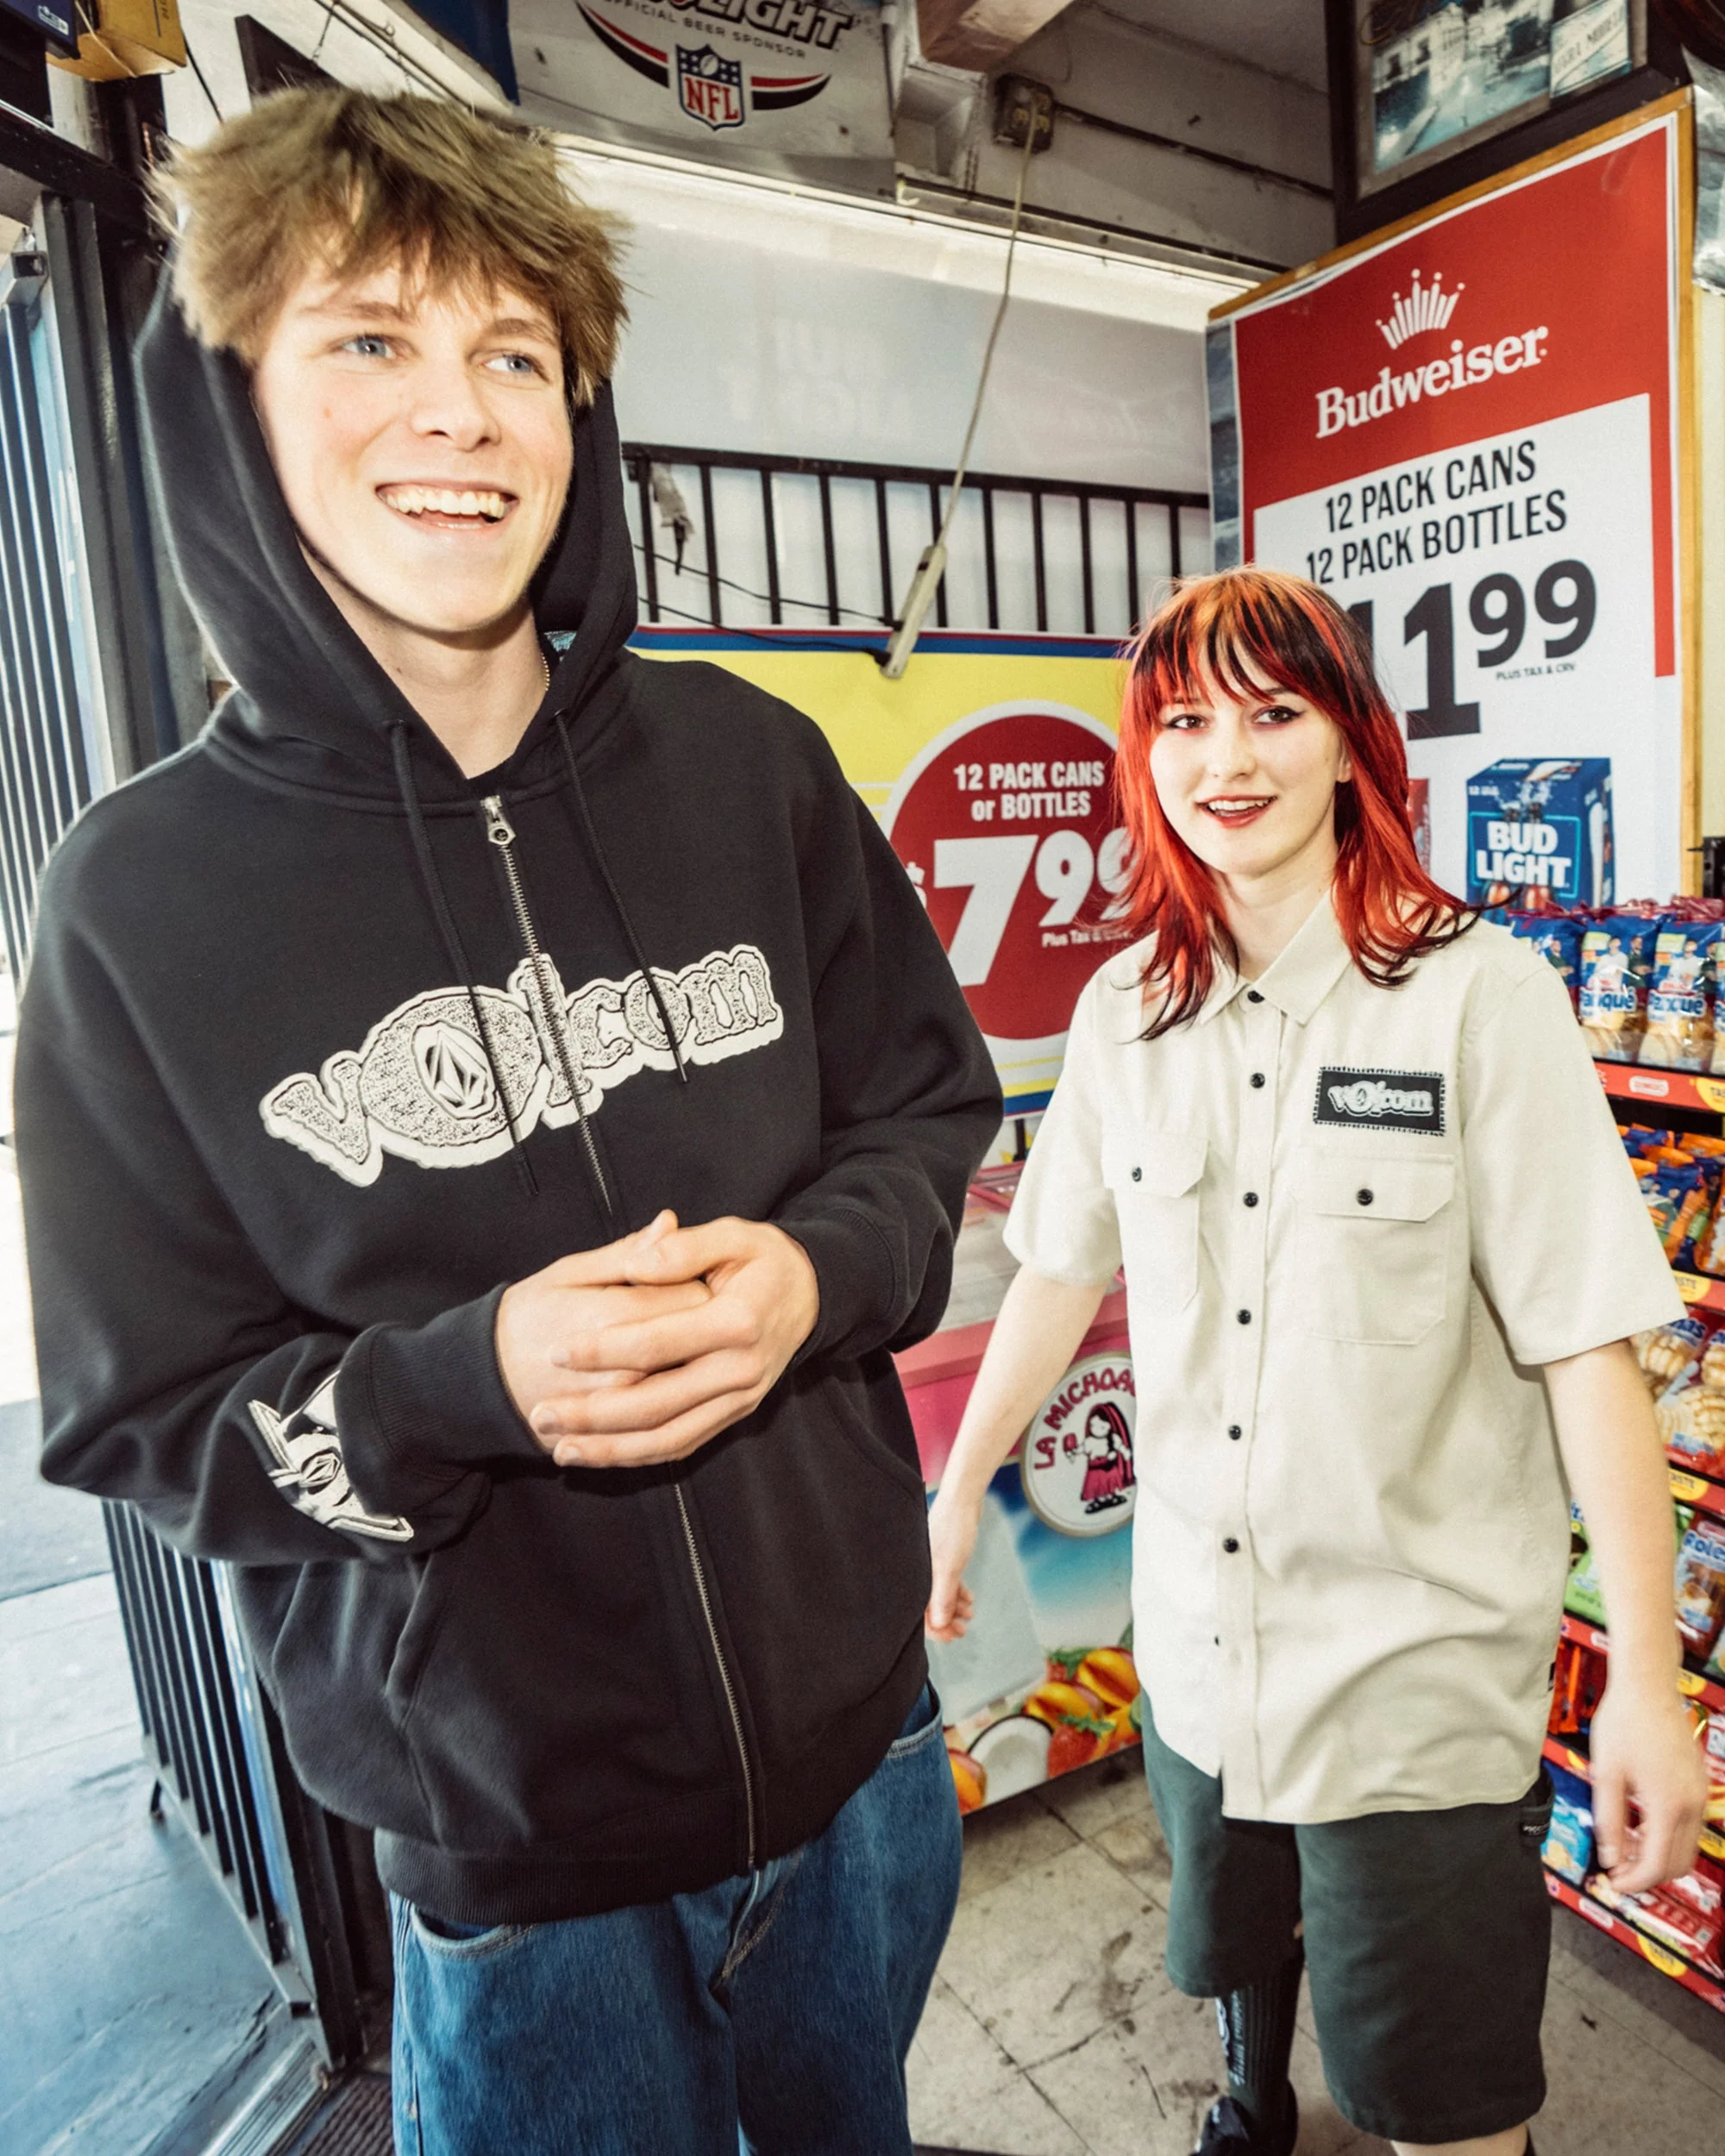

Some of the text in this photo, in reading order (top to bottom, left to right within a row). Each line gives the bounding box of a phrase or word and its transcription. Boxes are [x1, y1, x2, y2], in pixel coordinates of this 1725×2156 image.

[606, 0, 676, 23] FICIAL
[683, 17, 725, 36] BEER
[732, 31, 806, 59] SPONSOR
[684, 77, 739, 122] NFL
[1315, 326, 1549, 438] Budweiser
[1326, 440, 1537, 532] 12 PACK CANS
[1306, 489, 1567, 586] 12 PACK BOTTLES
[953, 761, 1105, 791] 12 PACK CANS
[971, 791, 1091, 822] or BOTTLES
[1487, 820, 1558, 855] BUD
[1476, 849, 1572, 888] LIGHT
[1041, 931, 1069, 948] Plus
[1044, 1367, 1136, 1431] MICHOA
[1034, 1435, 1057, 1470] LA
[1683, 1531, 1725, 1563] Role
